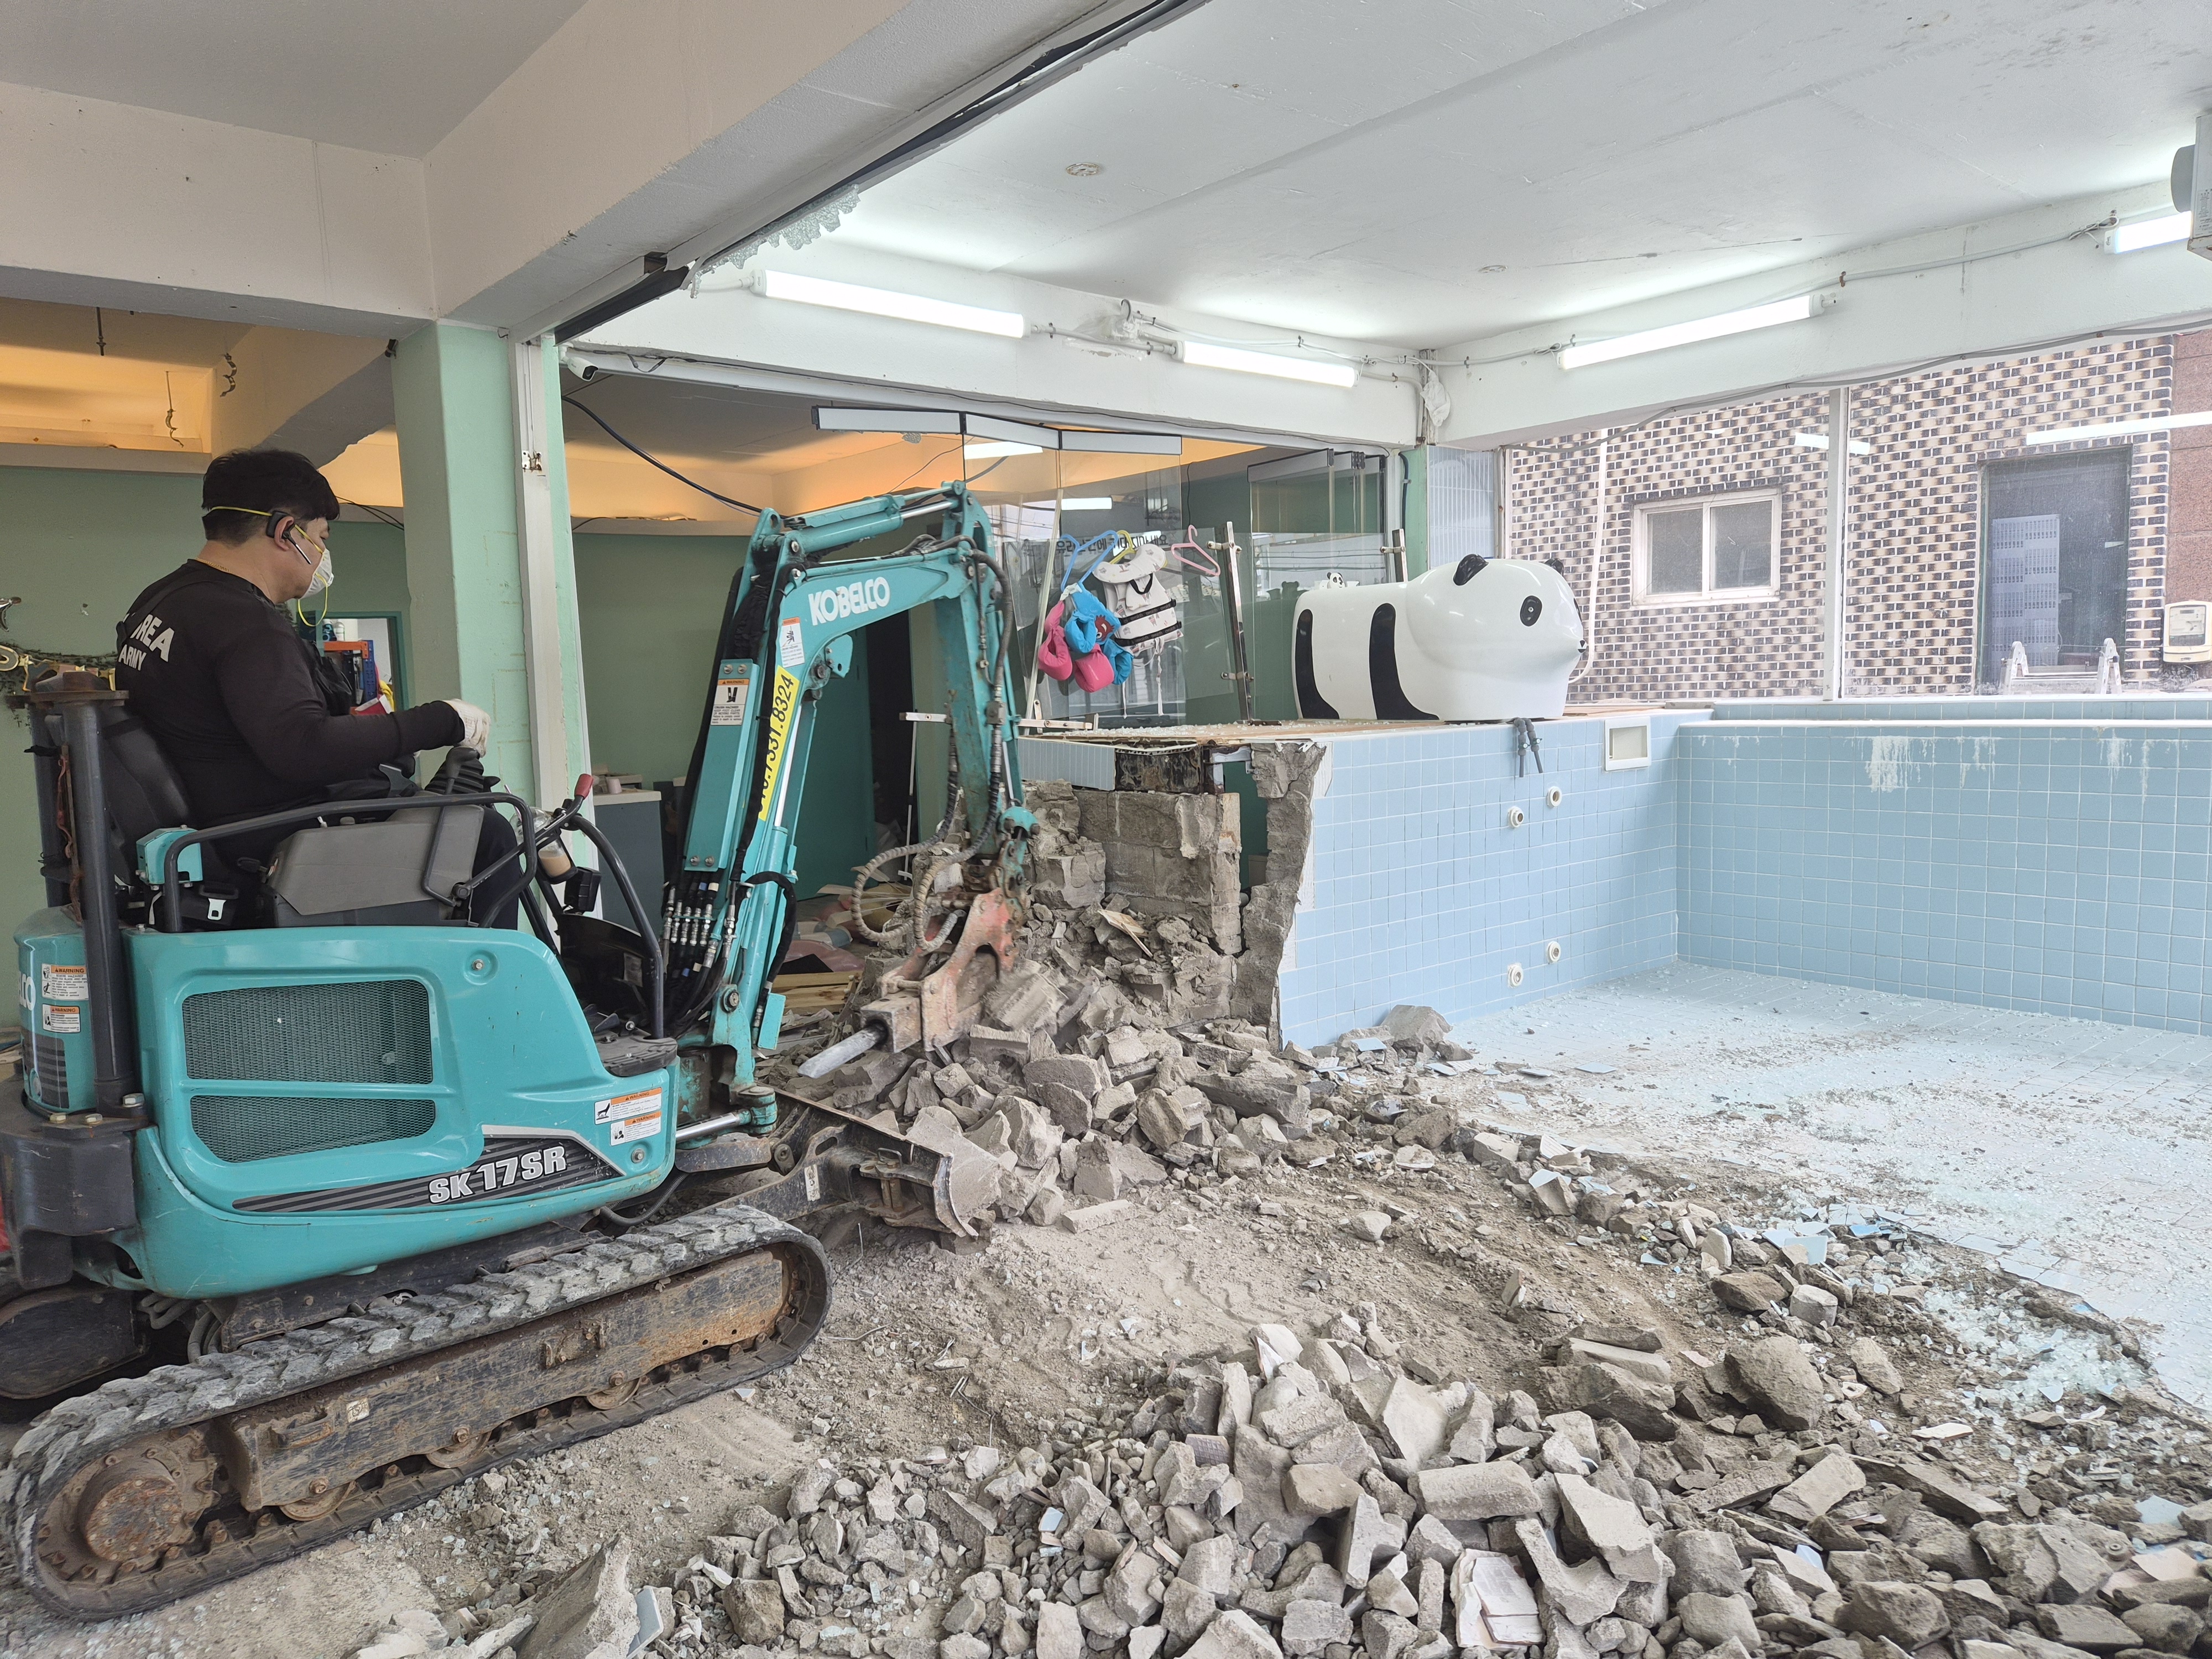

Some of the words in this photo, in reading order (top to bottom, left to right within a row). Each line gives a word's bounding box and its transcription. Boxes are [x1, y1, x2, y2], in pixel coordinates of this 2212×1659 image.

[808, 577, 890, 625] KOBELCO
[118, 644, 147, 671] ARMY
[636, 1114, 656, 1122] WARNING
